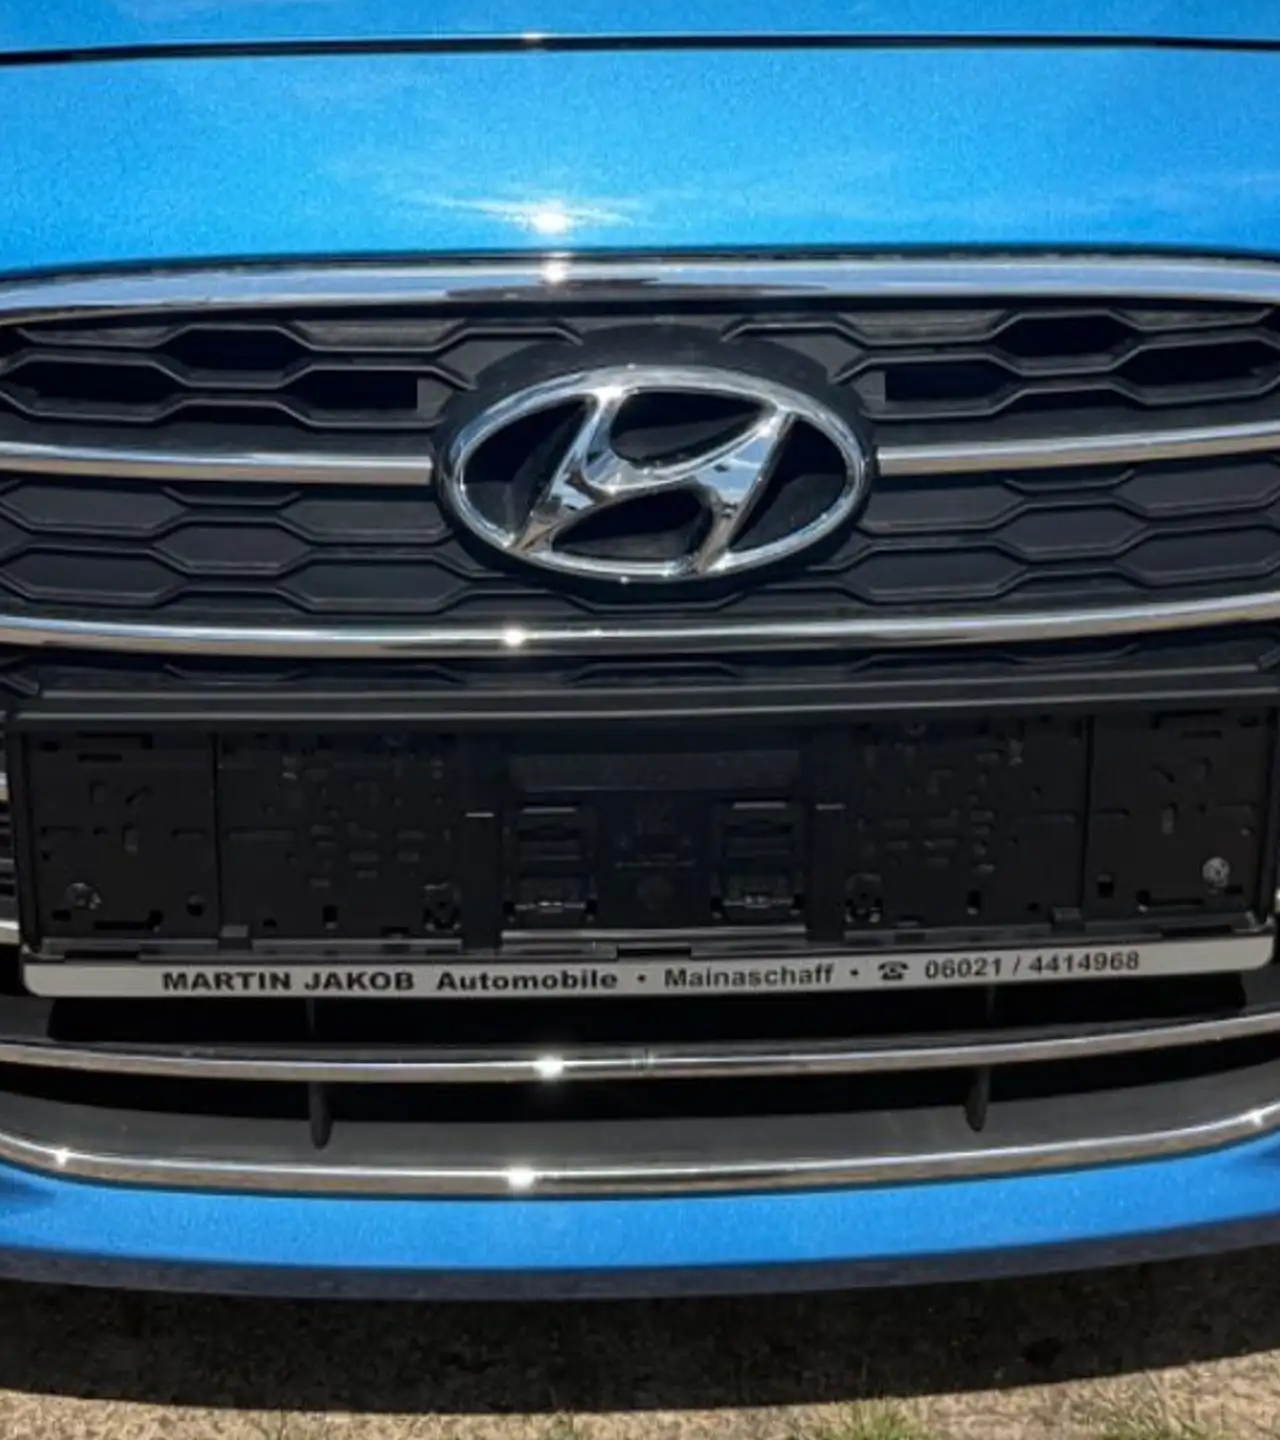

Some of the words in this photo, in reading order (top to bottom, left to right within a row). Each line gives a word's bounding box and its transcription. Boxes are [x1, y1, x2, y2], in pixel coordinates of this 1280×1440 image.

[161, 970, 292, 992] MARTIN
[303, 970, 415, 992] JAKOB
[435, 969, 618, 992] Automobile
[663, 963, 835, 989] Mainaschaff
[924, 956, 1003, 980] 06021
[1027, 950, 1141, 976] 4414968
